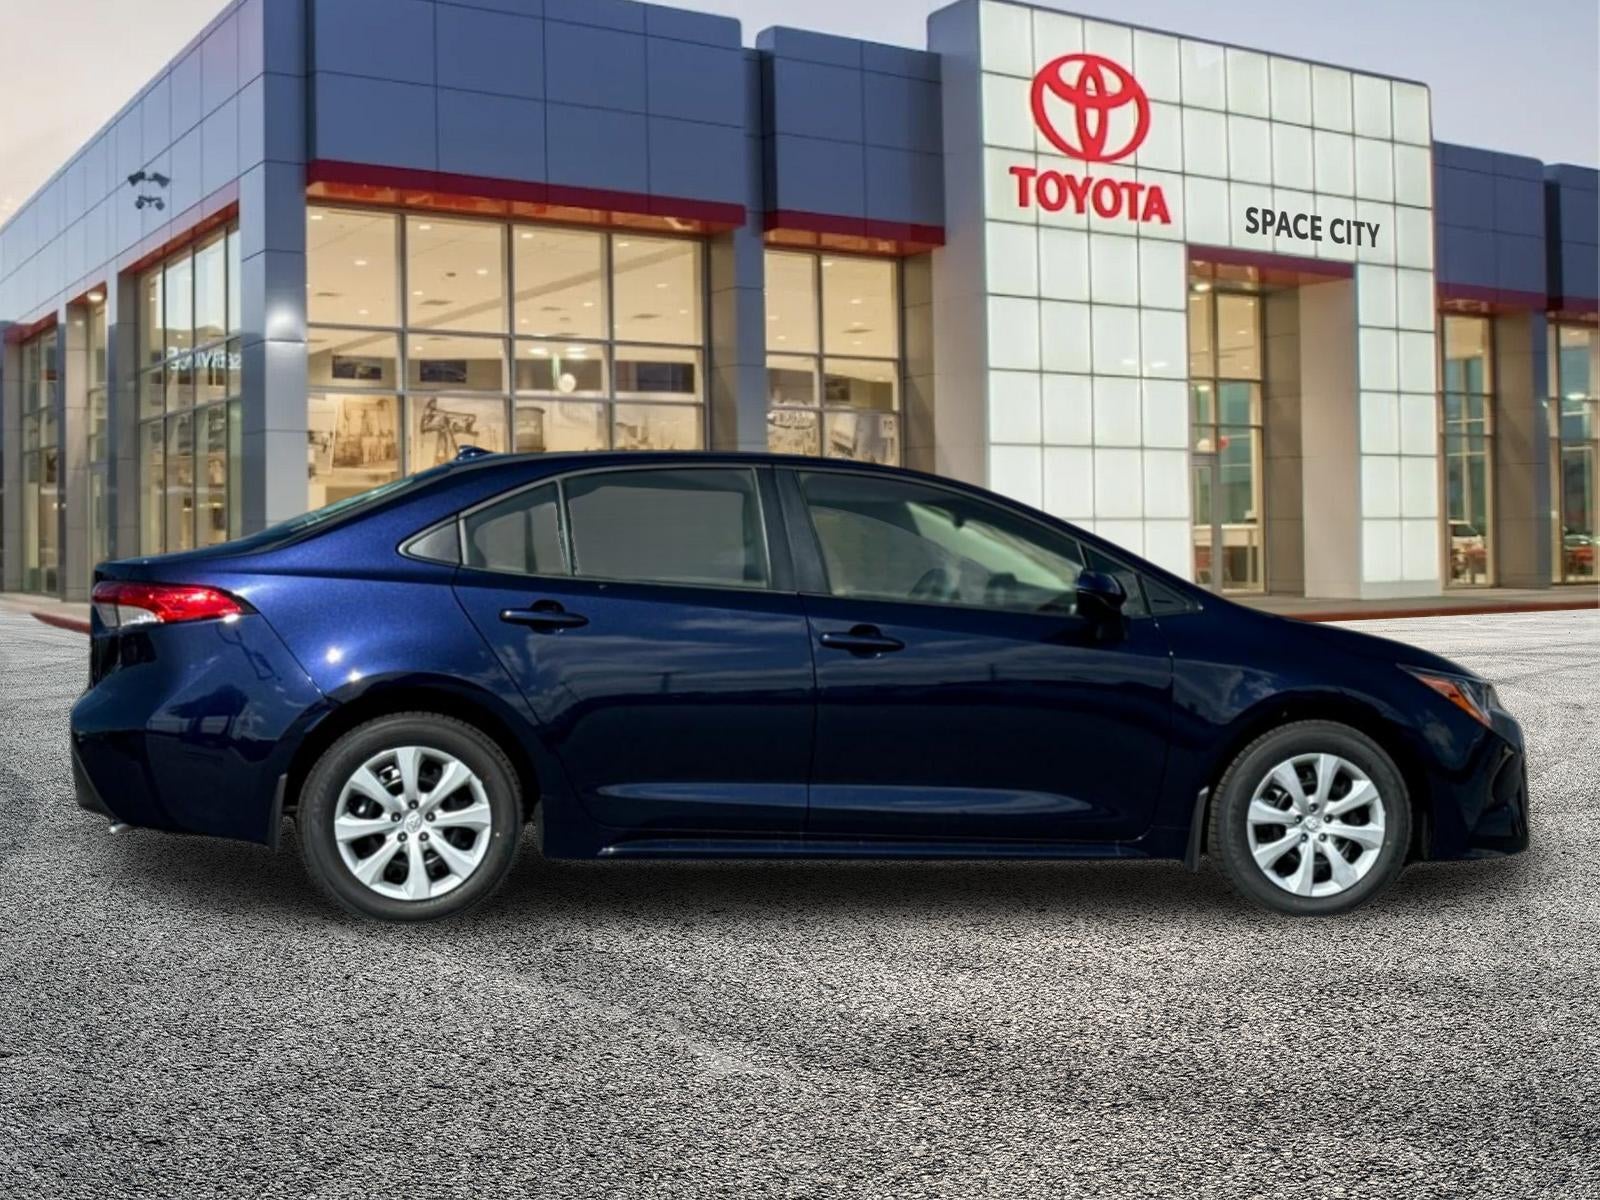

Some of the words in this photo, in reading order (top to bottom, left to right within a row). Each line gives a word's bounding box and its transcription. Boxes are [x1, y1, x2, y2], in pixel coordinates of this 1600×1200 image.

[1009, 166, 1171, 224] TOYOTA
[1245, 206, 1322, 242] SPACE
[1329, 217, 1380, 248] CITY
